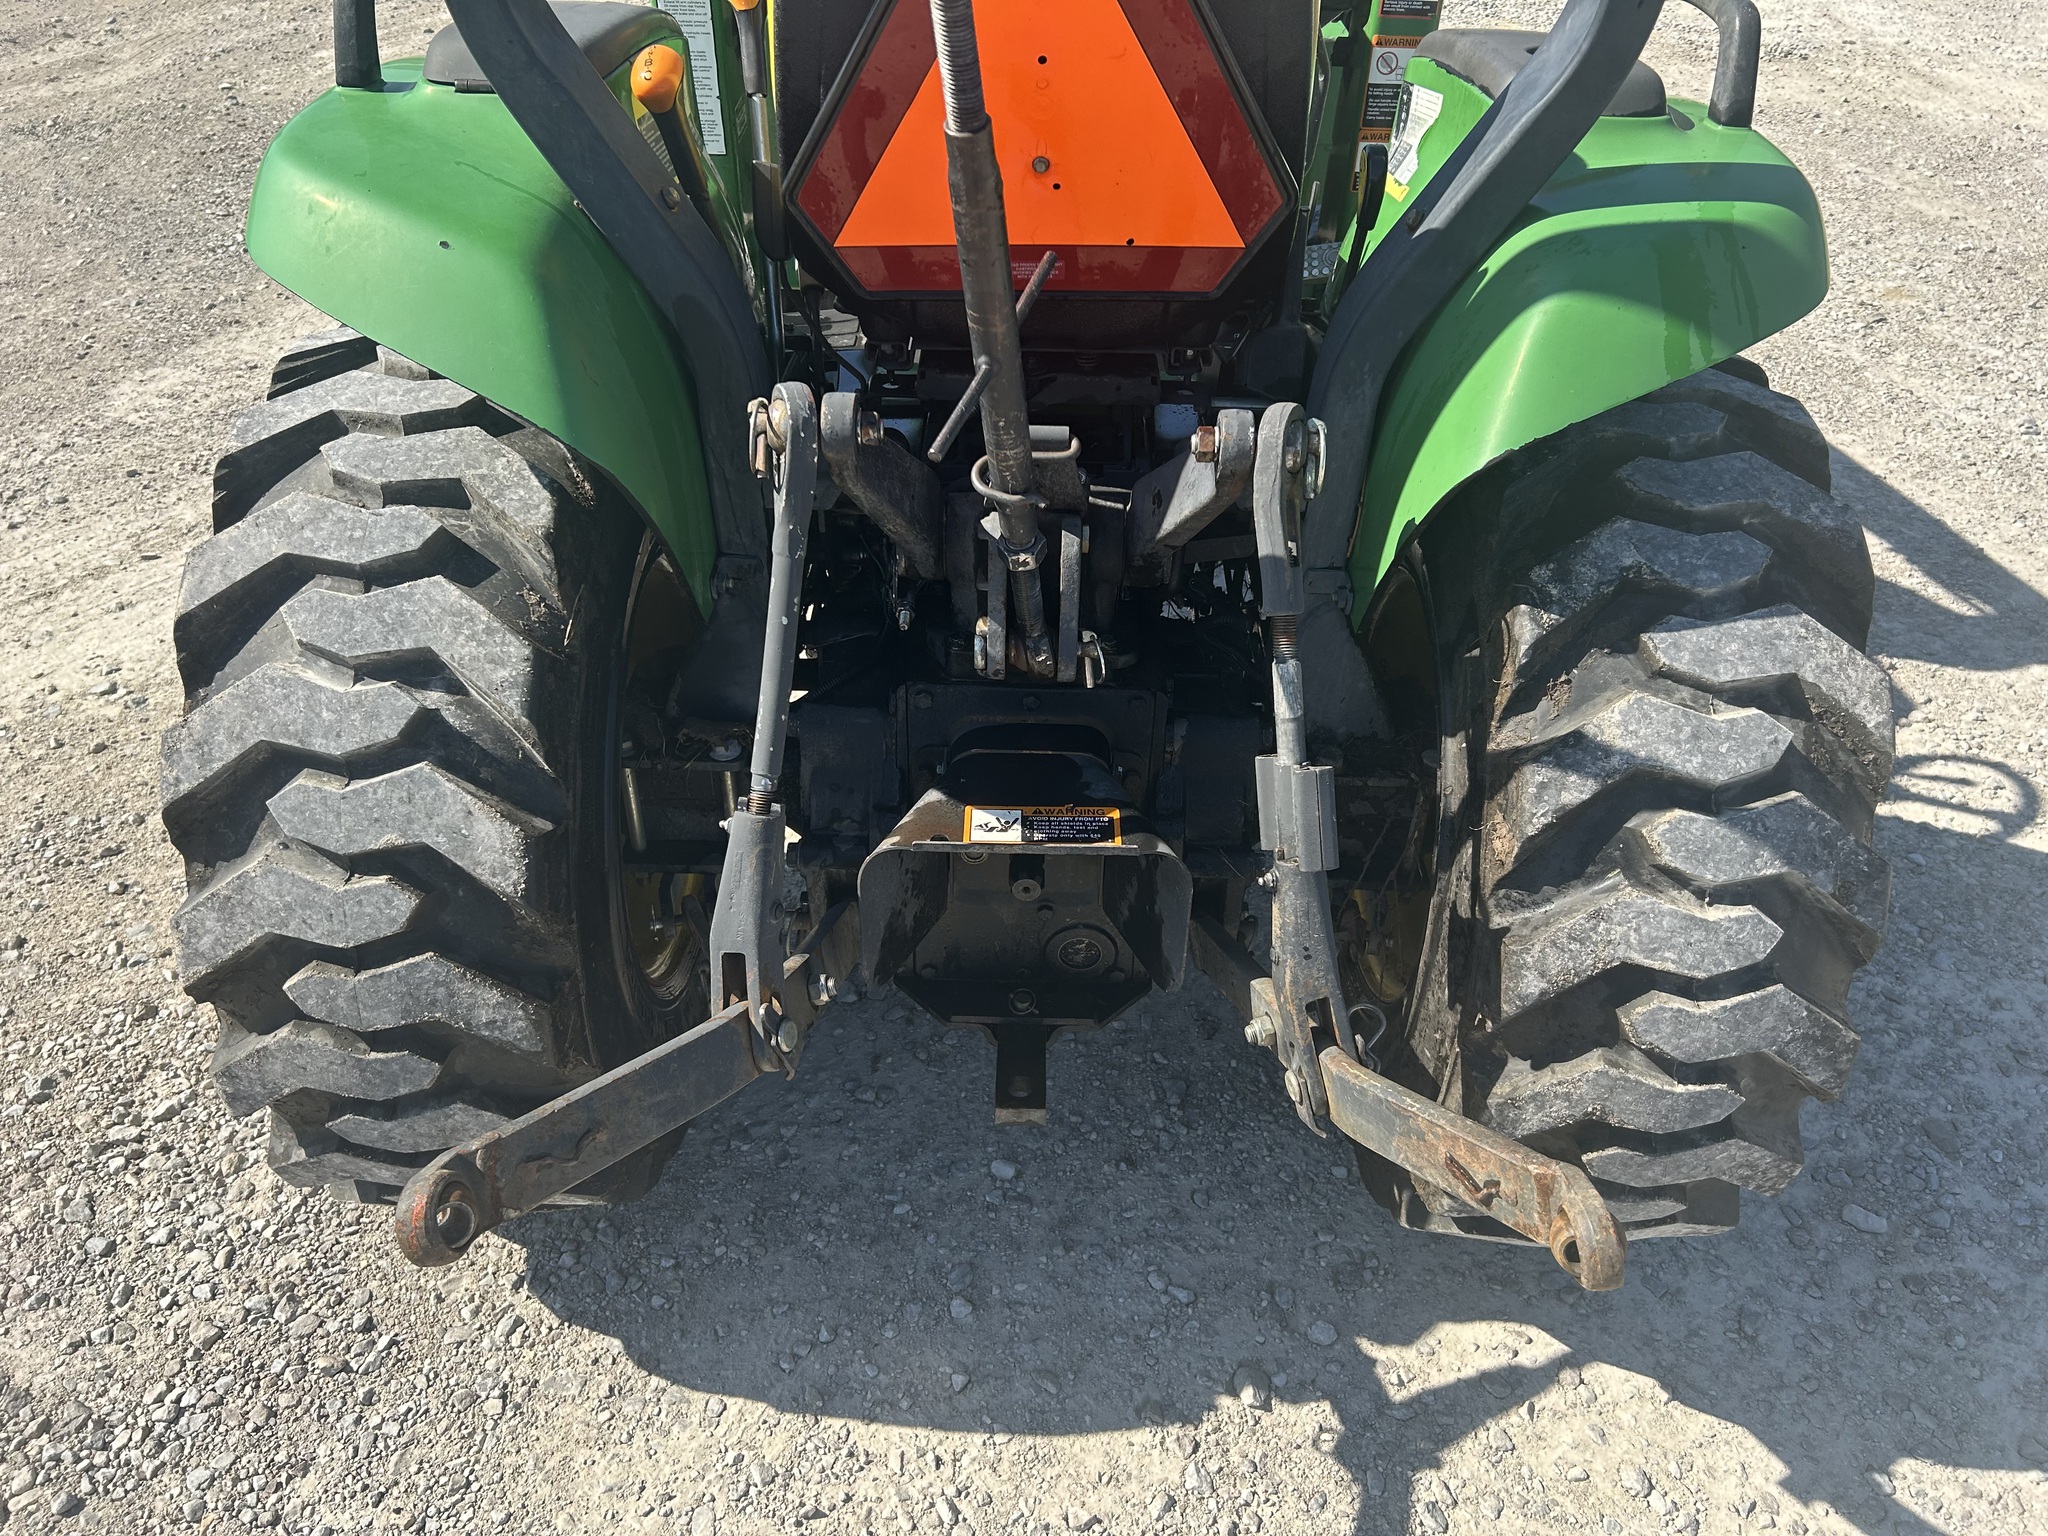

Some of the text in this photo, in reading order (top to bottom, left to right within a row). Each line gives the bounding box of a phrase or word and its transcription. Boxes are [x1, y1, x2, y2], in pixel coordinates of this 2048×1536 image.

[1385, 38, 1421, 46] WARNIN
[645, 58, 653, 67] B
[1044, 808, 1105, 816] WARNING
